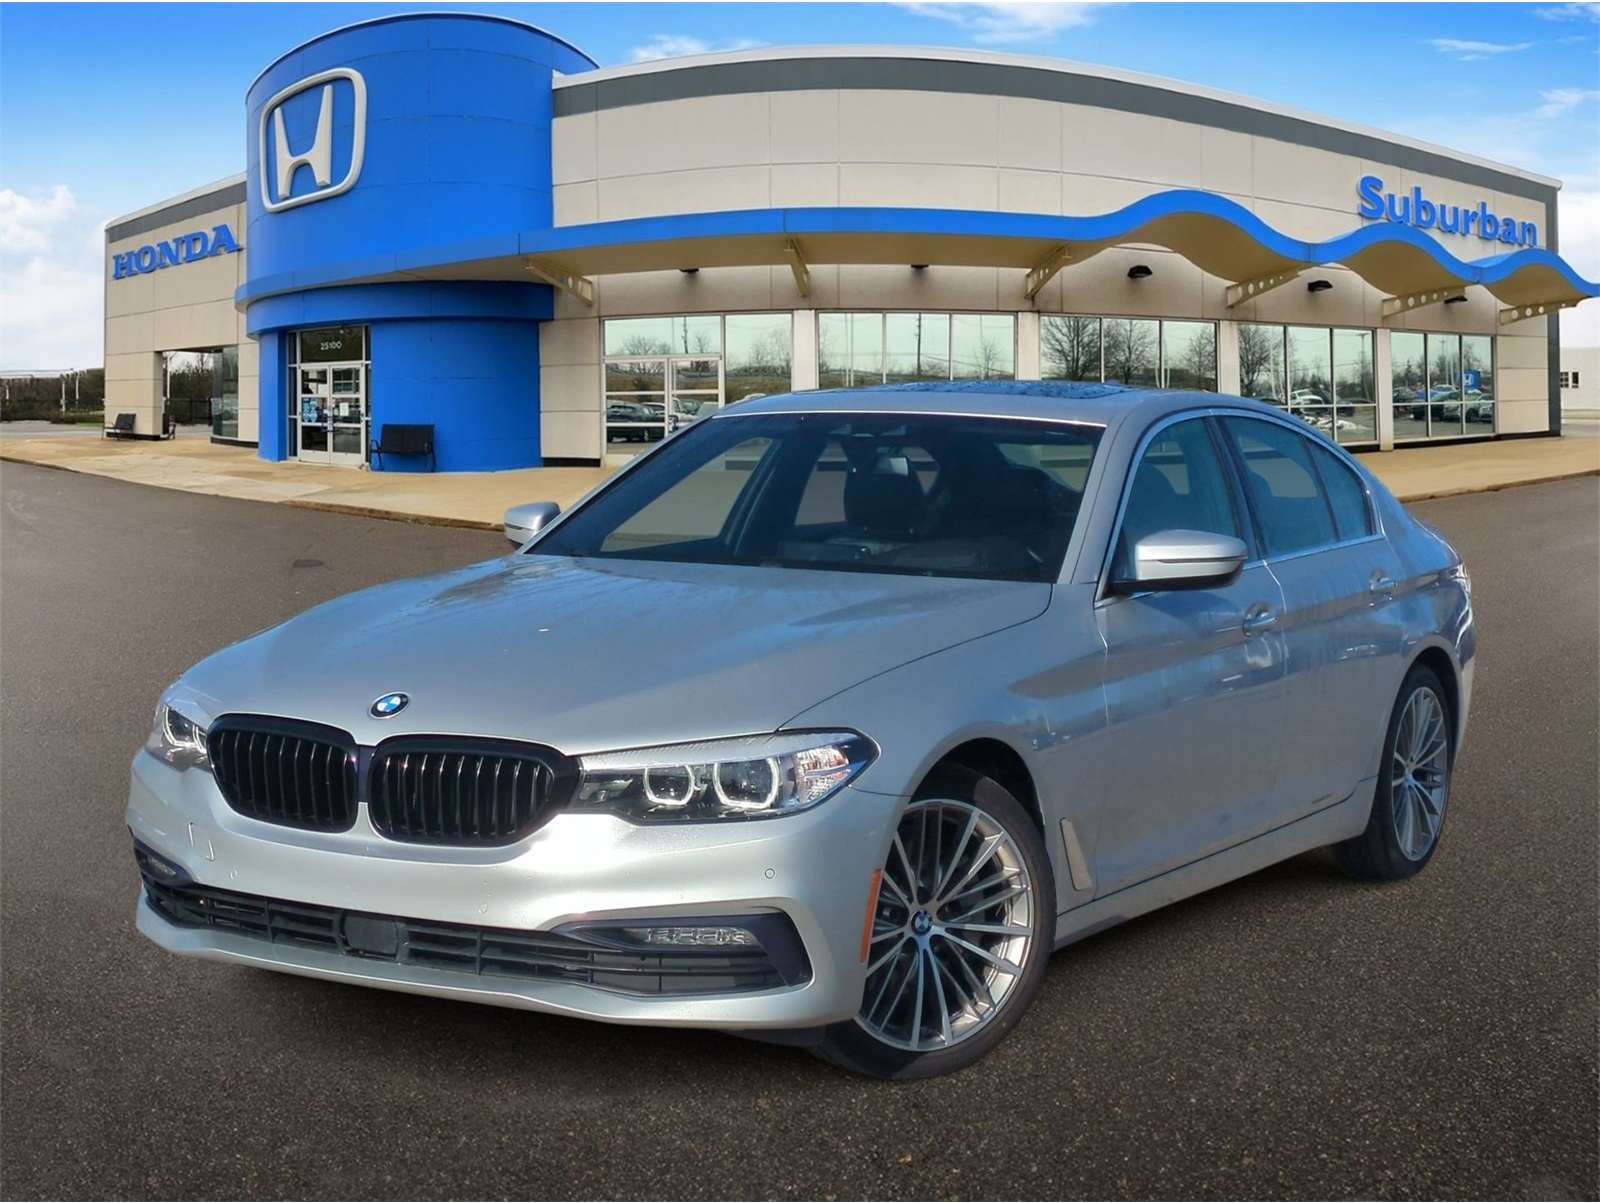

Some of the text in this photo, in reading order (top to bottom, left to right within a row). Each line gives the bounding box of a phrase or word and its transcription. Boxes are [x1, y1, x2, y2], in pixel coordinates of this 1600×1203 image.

[1358, 175, 1537, 247] Suburban
[112, 224, 241, 280] HONDA
[320, 340, 342, 350] 25100
